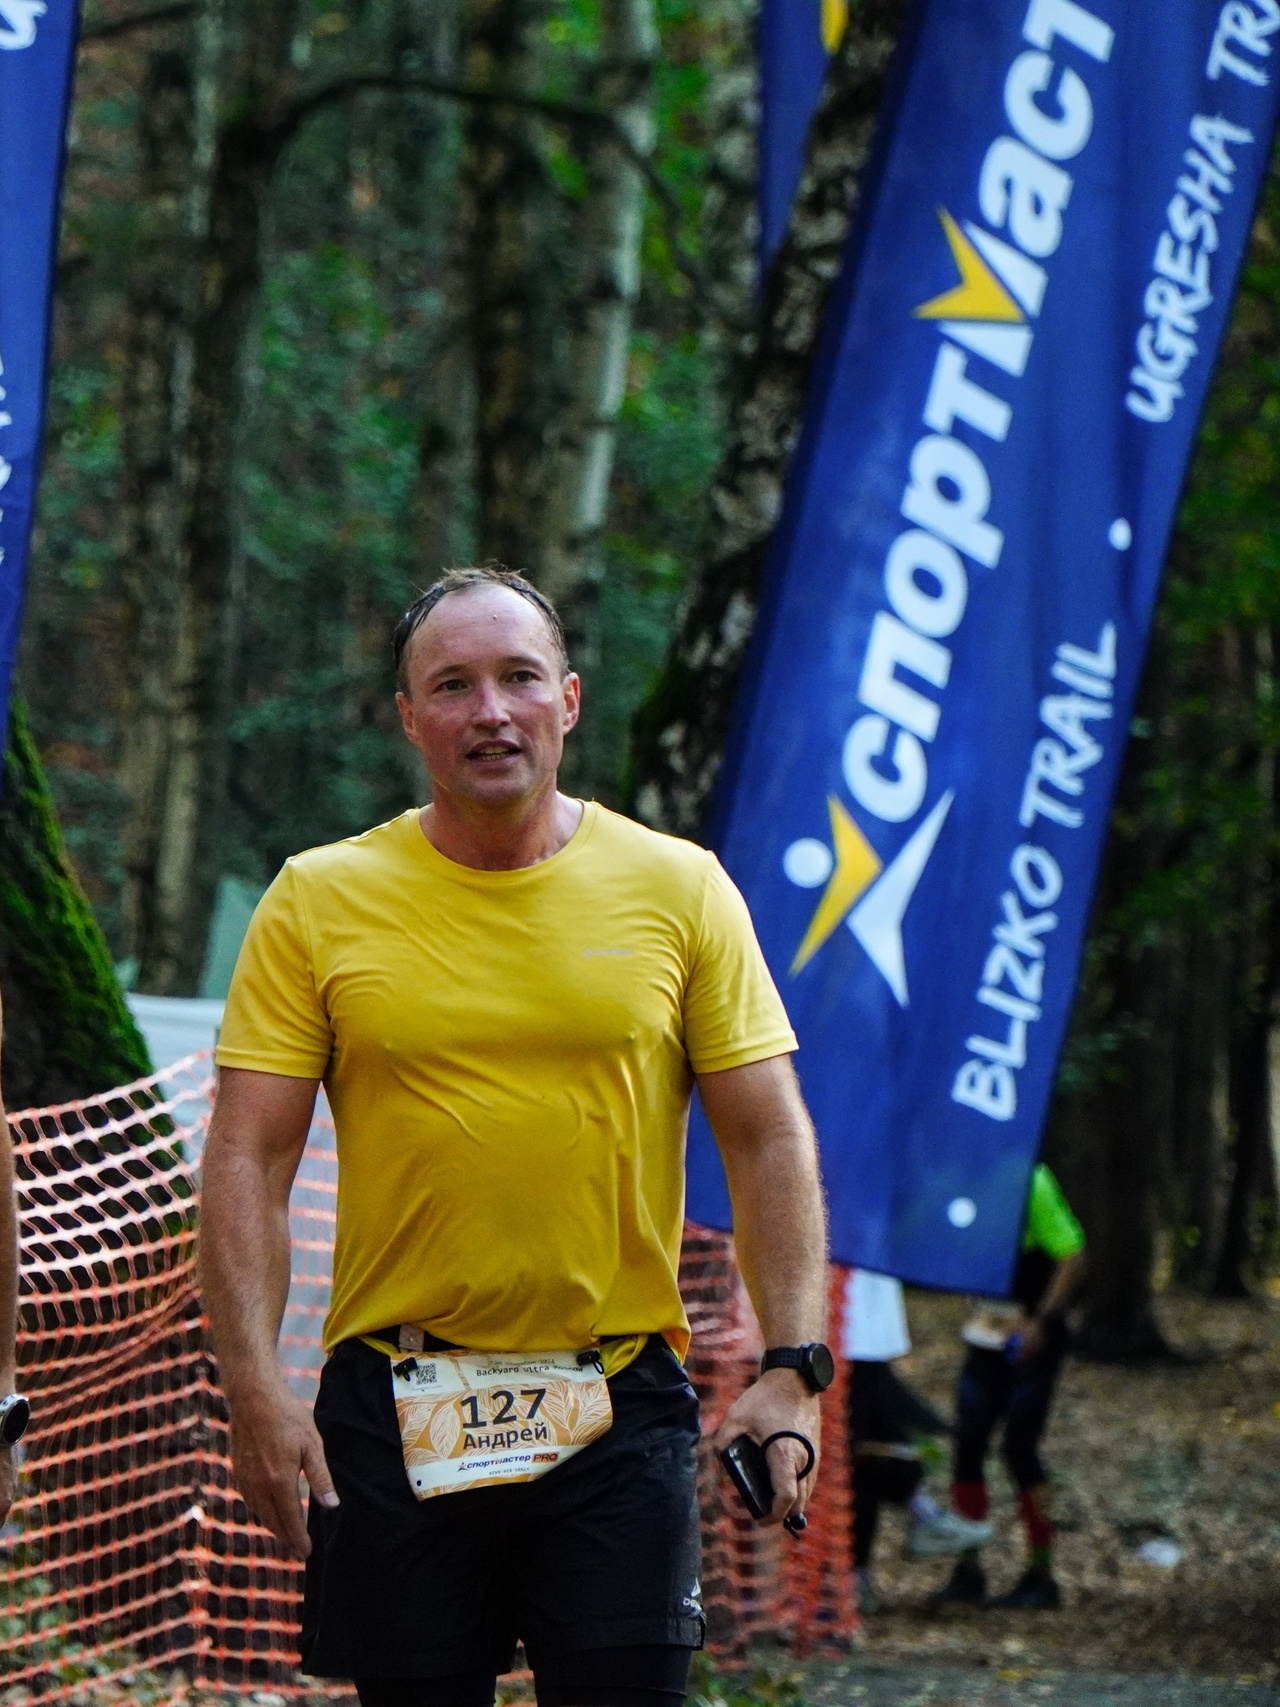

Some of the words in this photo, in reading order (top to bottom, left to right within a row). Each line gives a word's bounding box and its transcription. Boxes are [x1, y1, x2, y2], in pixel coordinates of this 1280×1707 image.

[950, 842, 1064, 1123] BLIZKO
[1018, 619, 1118, 829] TRAIL
[1124, 112, 1256, 424] UGRESHA
[476, 1366, 520, 1377] Backyard
[461, 1388, 547, 1429] 127
[463, 1422, 548, 1450] Андрей
[532, 1453, 559, 1463] PRO
[682, 1597, 701, 1611] DE
